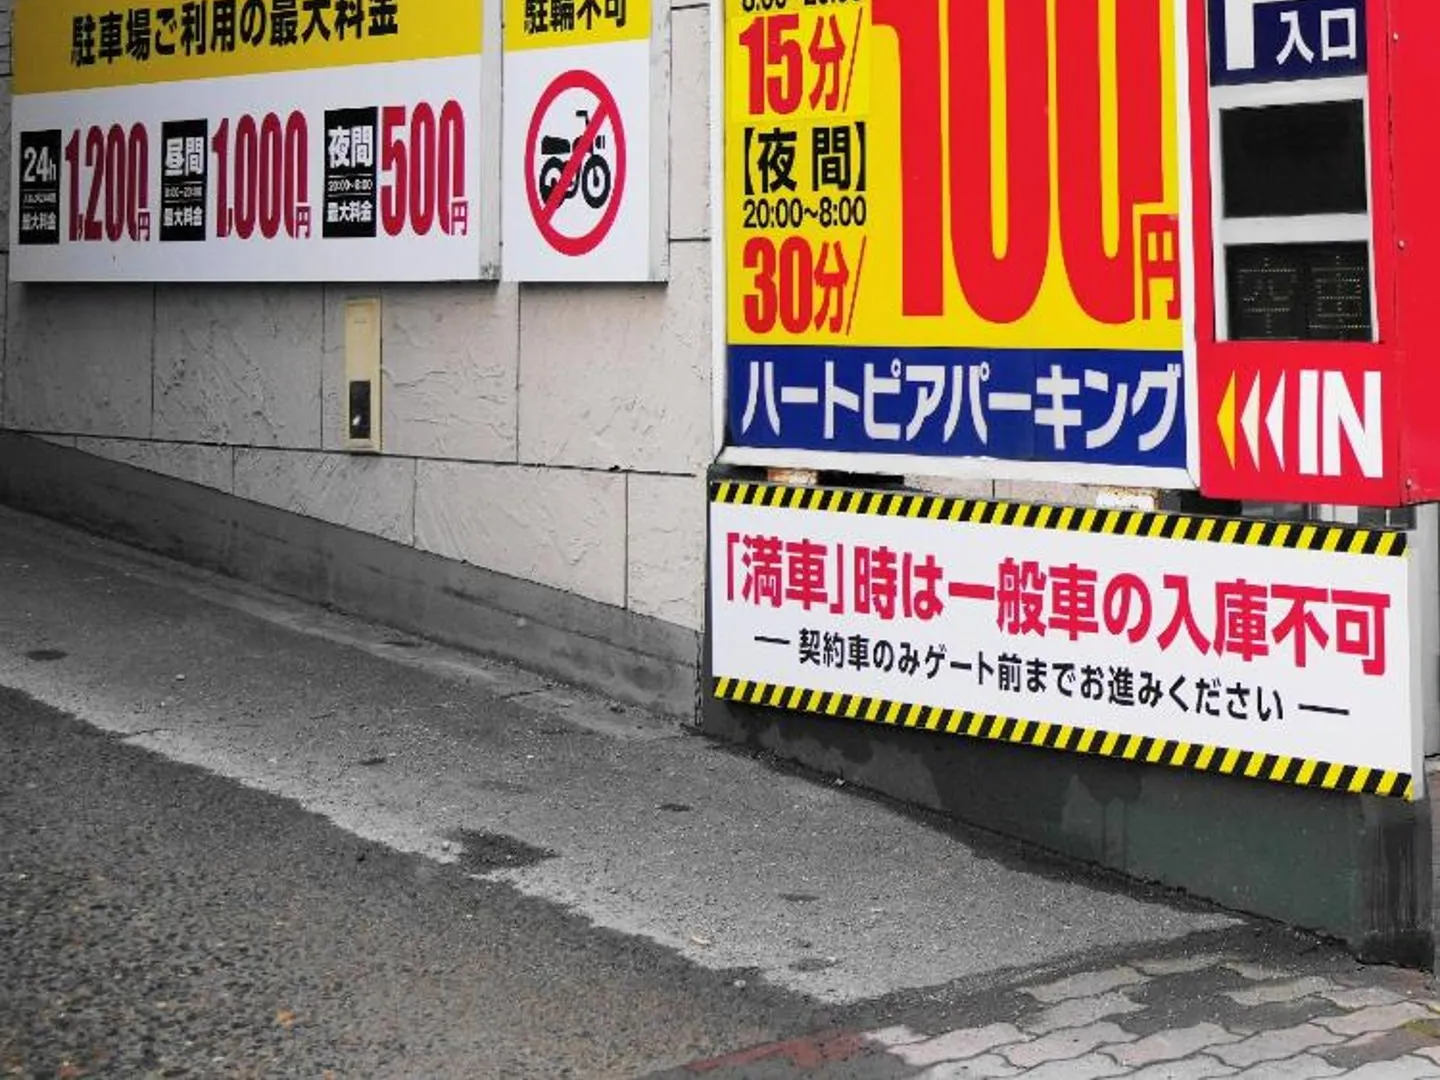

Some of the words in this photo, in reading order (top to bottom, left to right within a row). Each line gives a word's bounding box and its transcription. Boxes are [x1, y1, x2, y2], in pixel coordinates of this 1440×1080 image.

[1275, 7, 1358, 65] 入口
[23, 146, 57, 183] 24h
[163, 136, 205, 177] 昼間
[327, 124, 374, 169] 夜間
[380, 100, 468, 237] 500円
[162, 205, 203, 227] 最大料金
[326, 199, 373, 224] 最大料金
[740, 358, 1182, 451] ハートピアパーキング
[1298, 368, 1384, 479] IN
[726, 531, 1391, 677] 「満車」時は一般車の入庫不可
